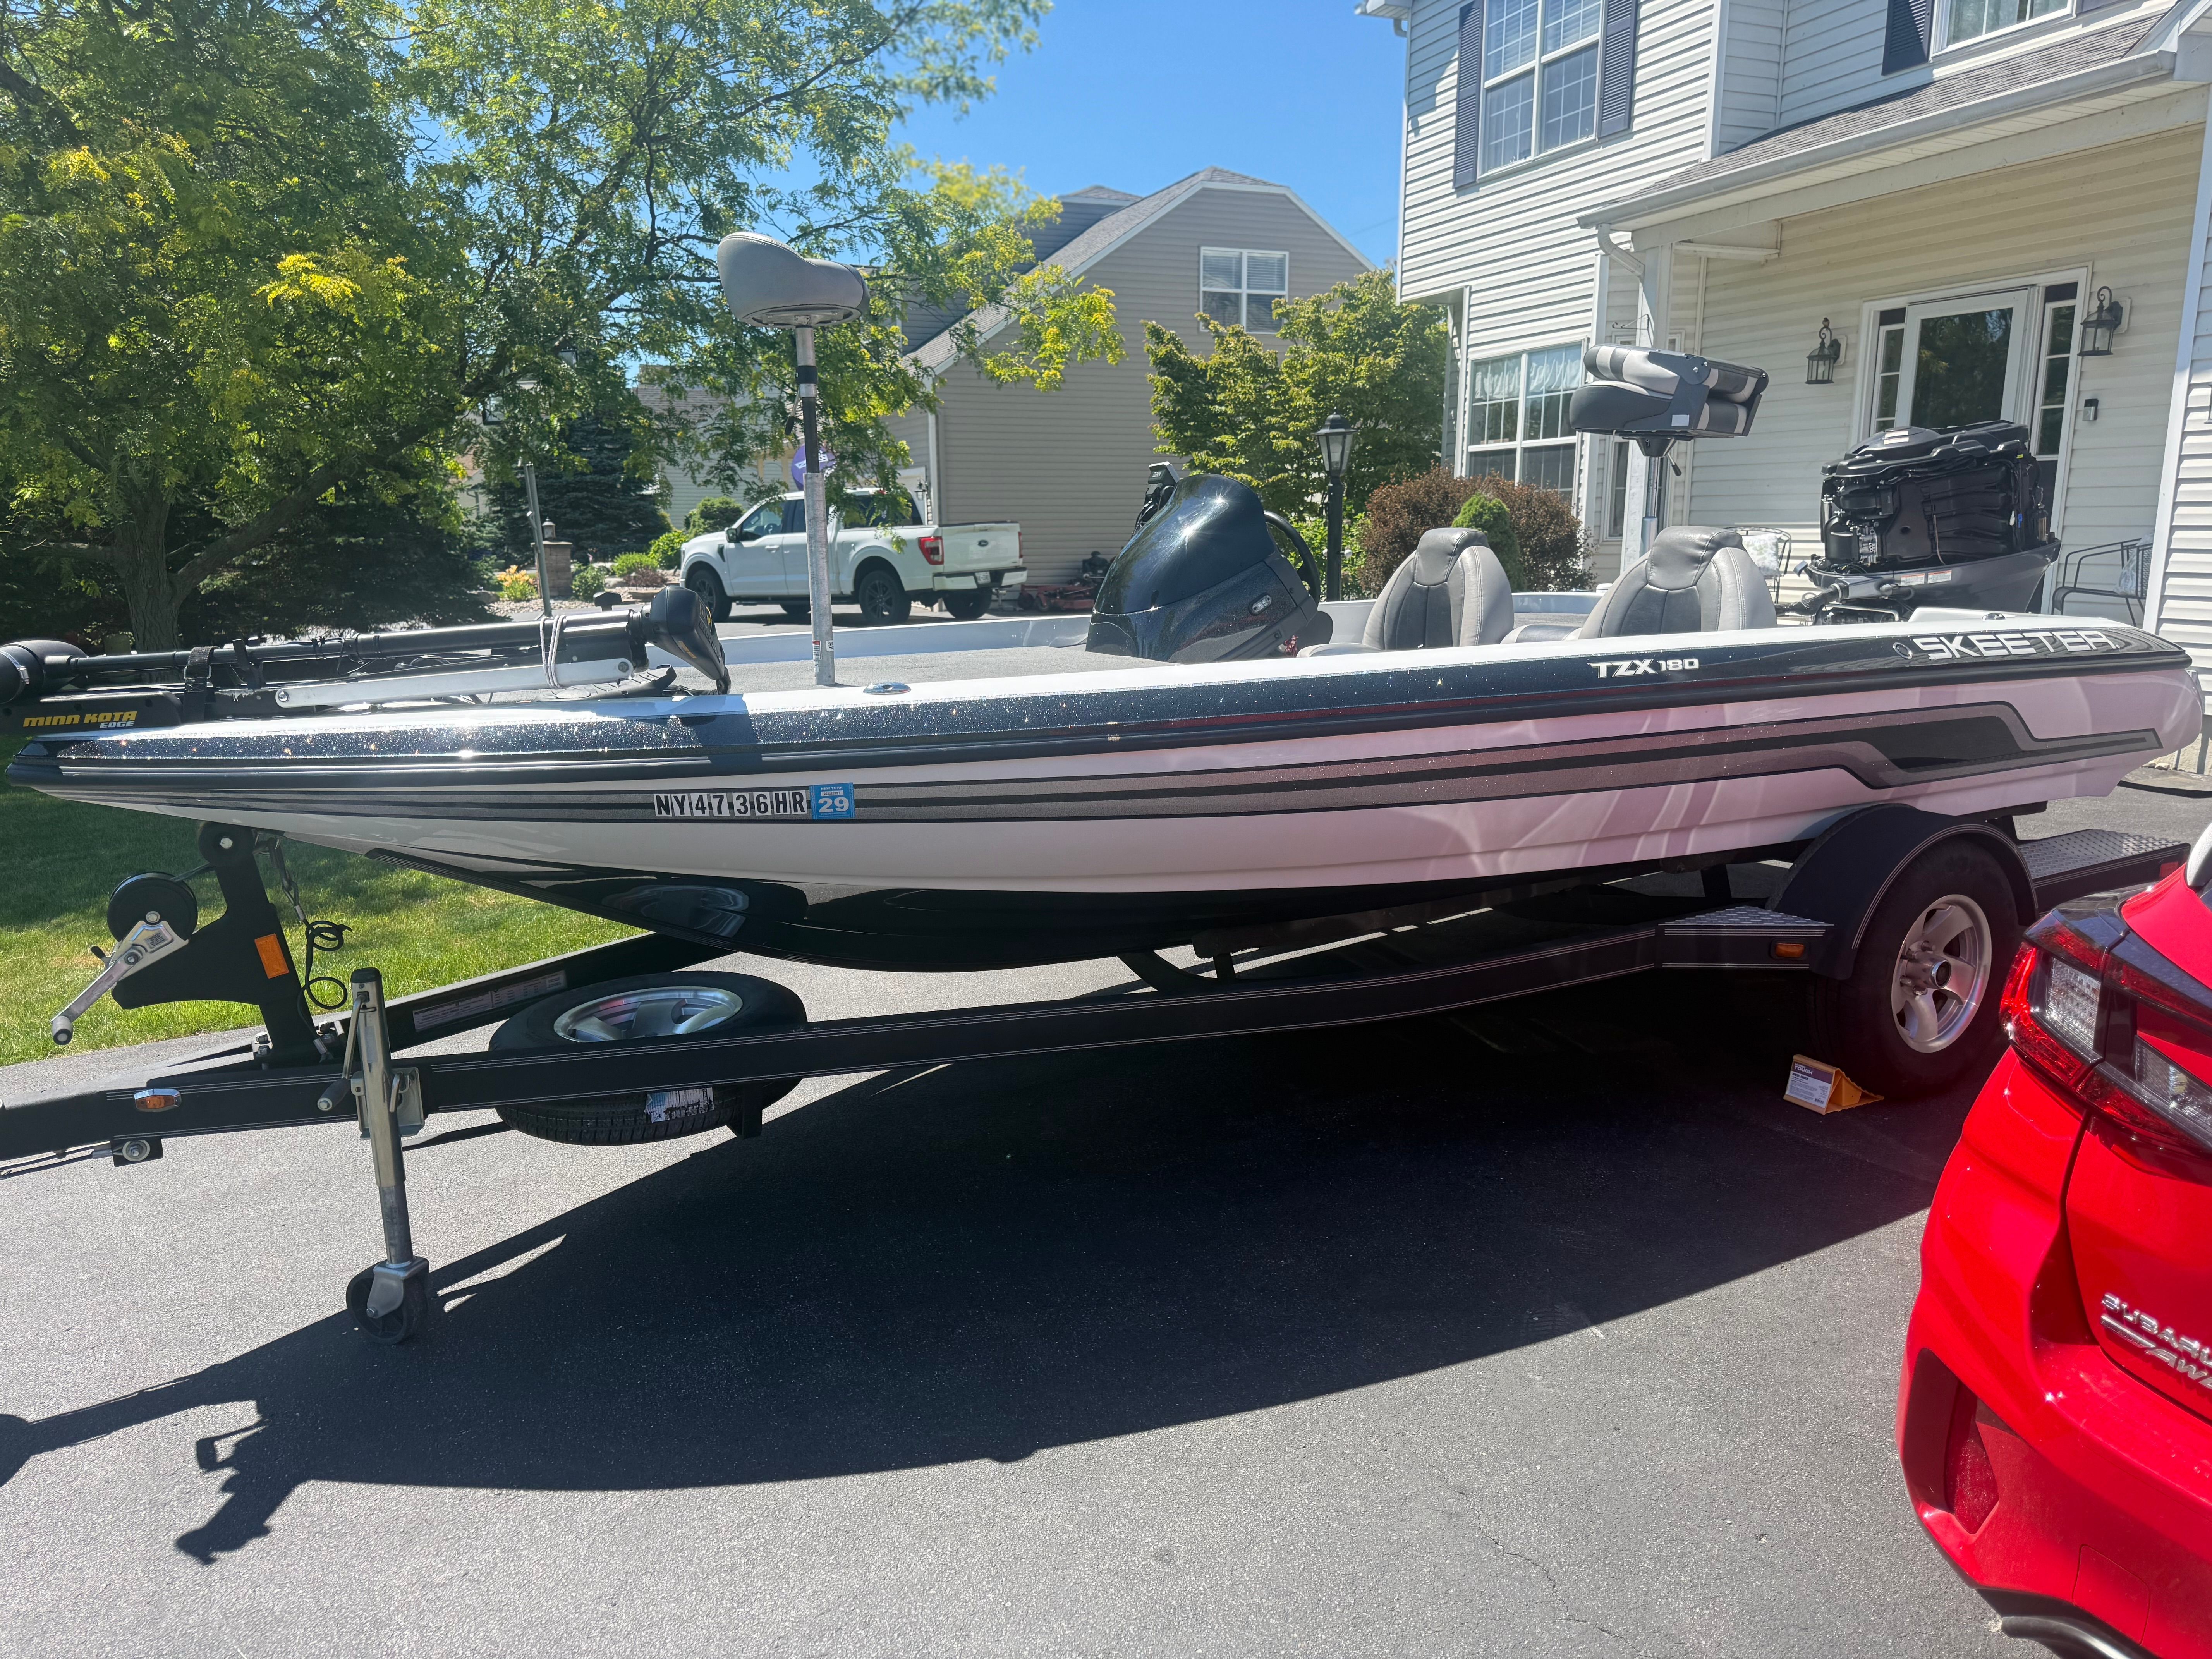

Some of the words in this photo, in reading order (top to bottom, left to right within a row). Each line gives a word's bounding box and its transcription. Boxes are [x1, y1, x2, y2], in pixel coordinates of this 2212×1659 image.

[1913, 630, 2117, 660] SKEETER
[1587, 658, 1658, 678] TZX
[1657, 658, 1700, 672] 180
[22, 714, 81, 727] MINN
[83, 711, 138, 723] KOTA
[99, 721, 135, 729] EDGE
[818, 797, 849, 813] 29
[1794, 1065, 1813, 1075] TOUGH
